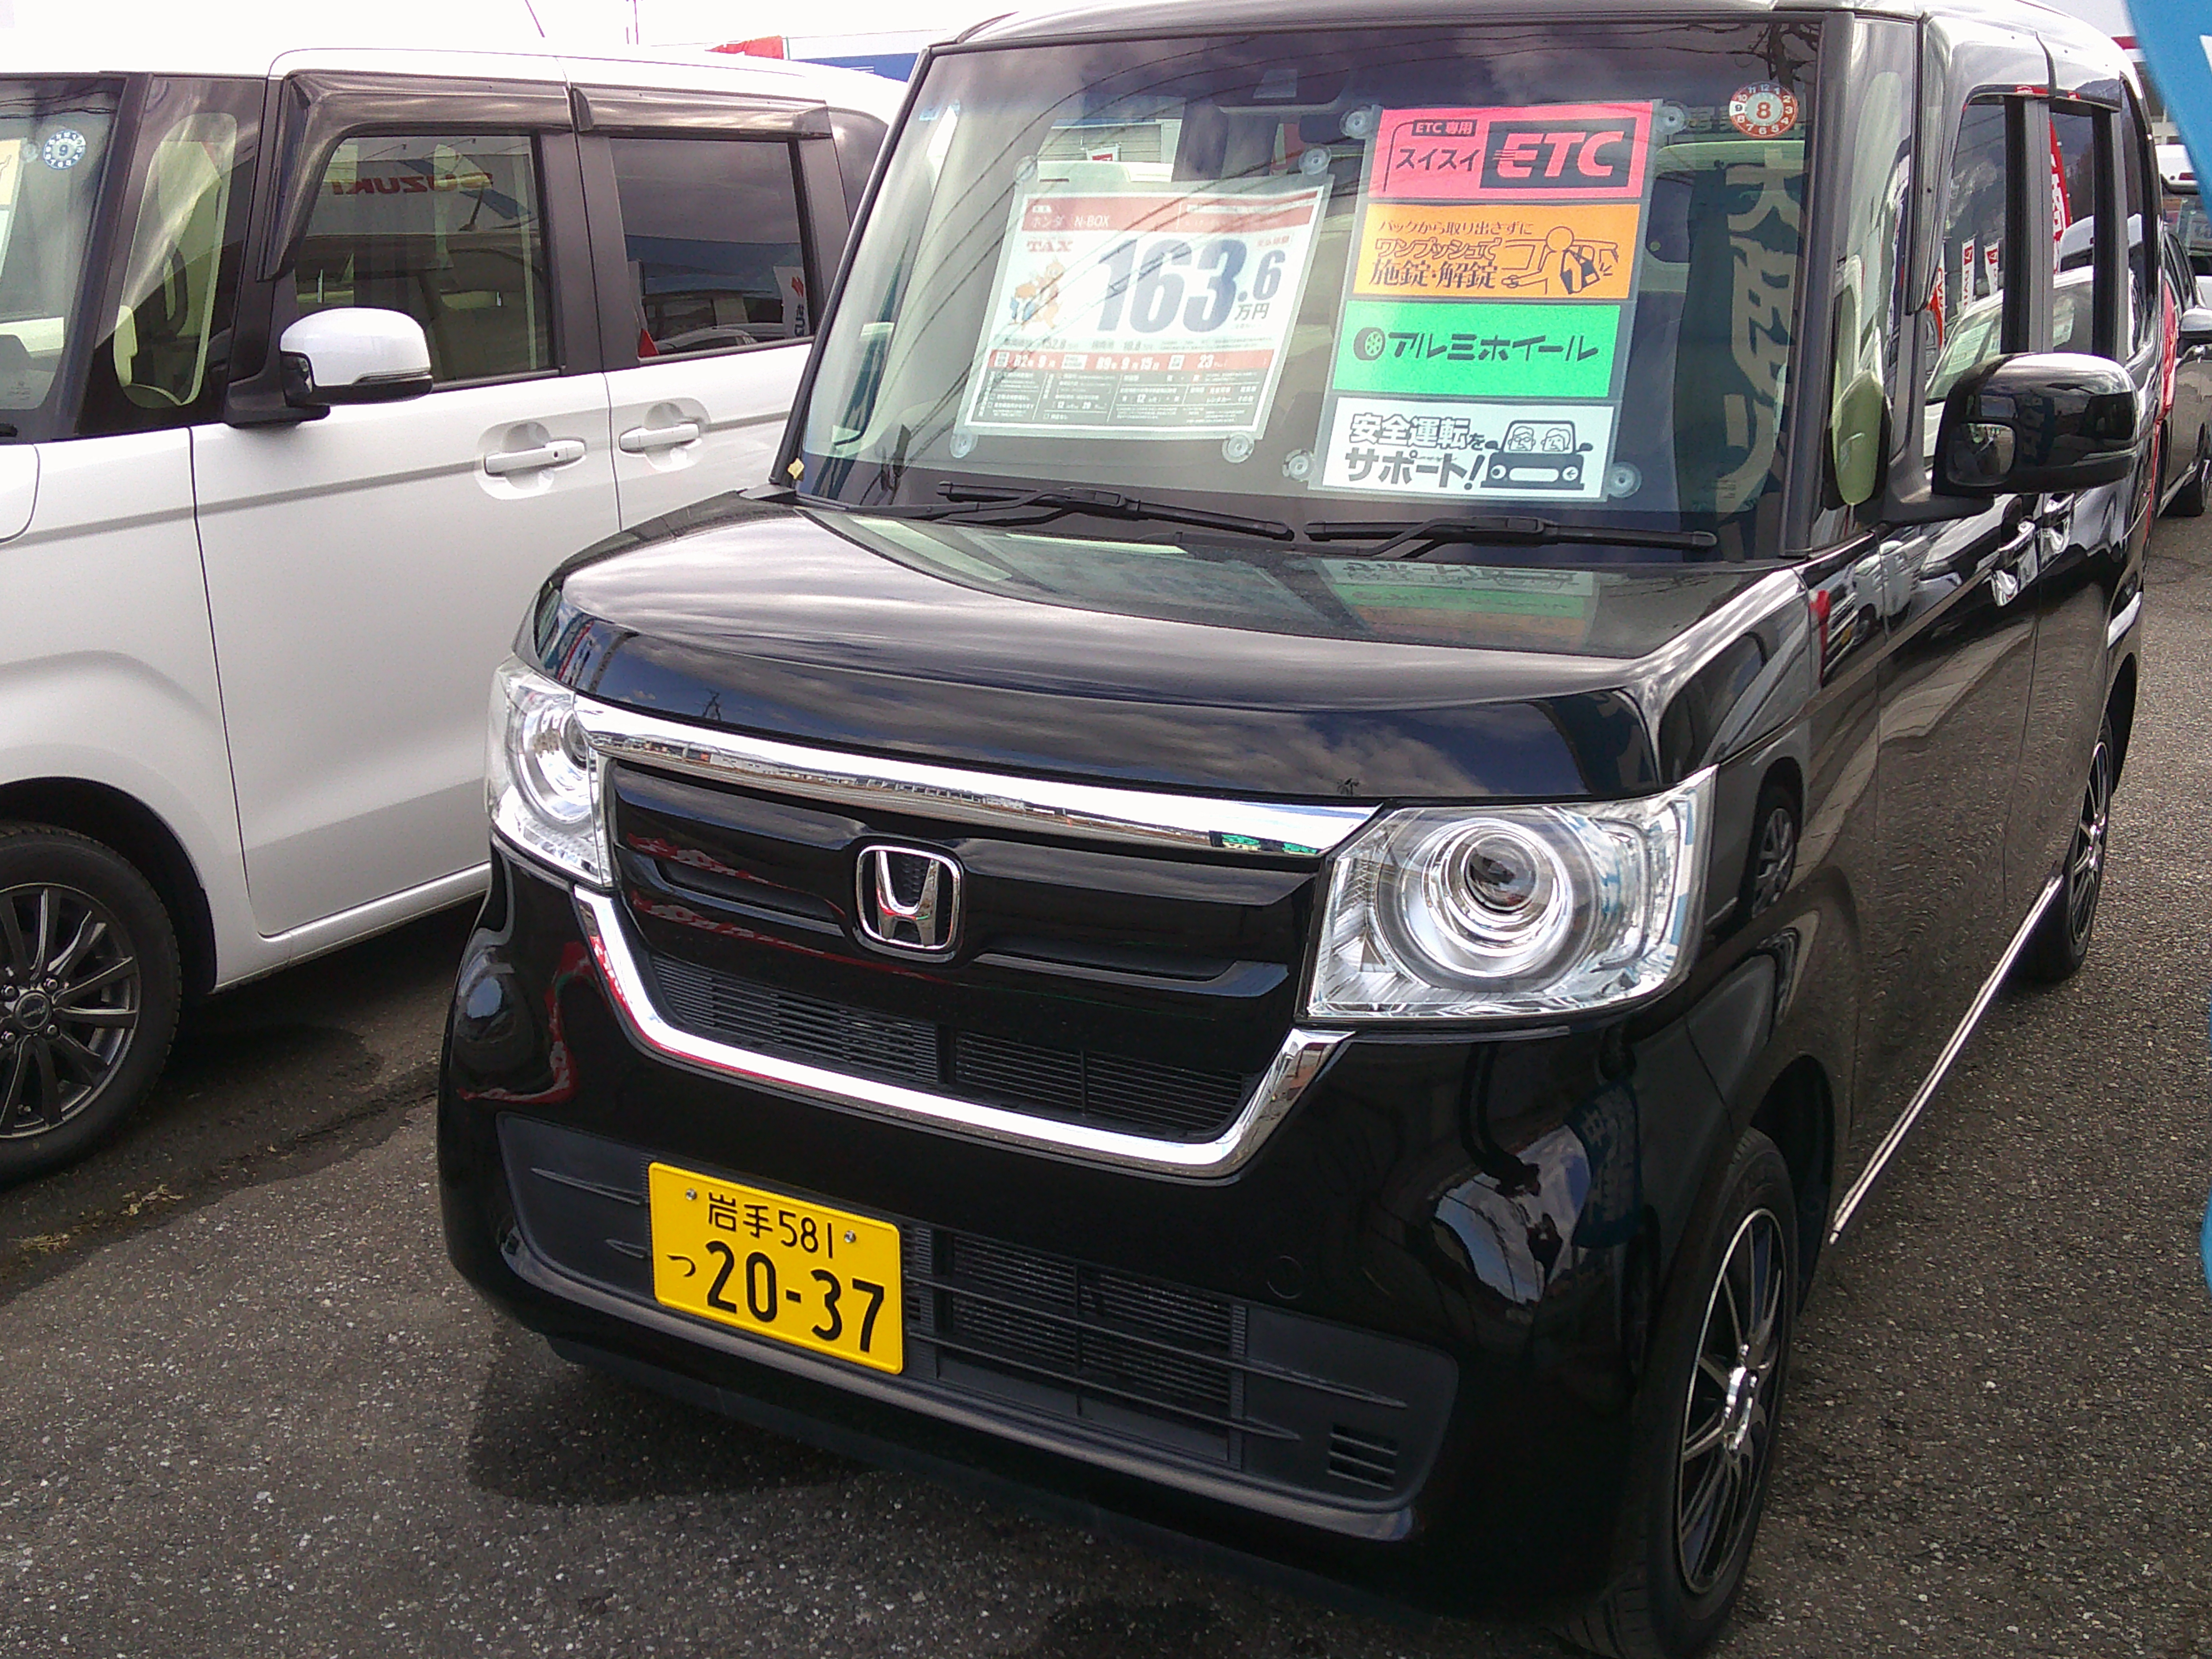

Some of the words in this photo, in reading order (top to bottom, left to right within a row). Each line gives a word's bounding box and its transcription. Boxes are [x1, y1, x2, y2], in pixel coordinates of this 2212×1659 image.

[1756, 102, 1771, 119] 8
[1415, 122, 1441, 134] ETC
[1445, 121, 1472, 135] 専用
[59, 145, 68, 156] 9
[1396, 147, 1480, 172] スイスイ
[1493, 131, 1624, 178] ETC
[1074, 215, 1110, 227] N-BOX
[1027, 240, 1073, 252] TAX
[1375, 237, 1502, 260] ワンプッシュで
[1234, 302, 1270, 321] 万円
[1388, 333, 1599, 362] アルミホイール
[1349, 412, 1485, 451] 安全運転を
[667, 1254, 696, 1277] つ
[705, 1240, 885, 1352] 20-37
